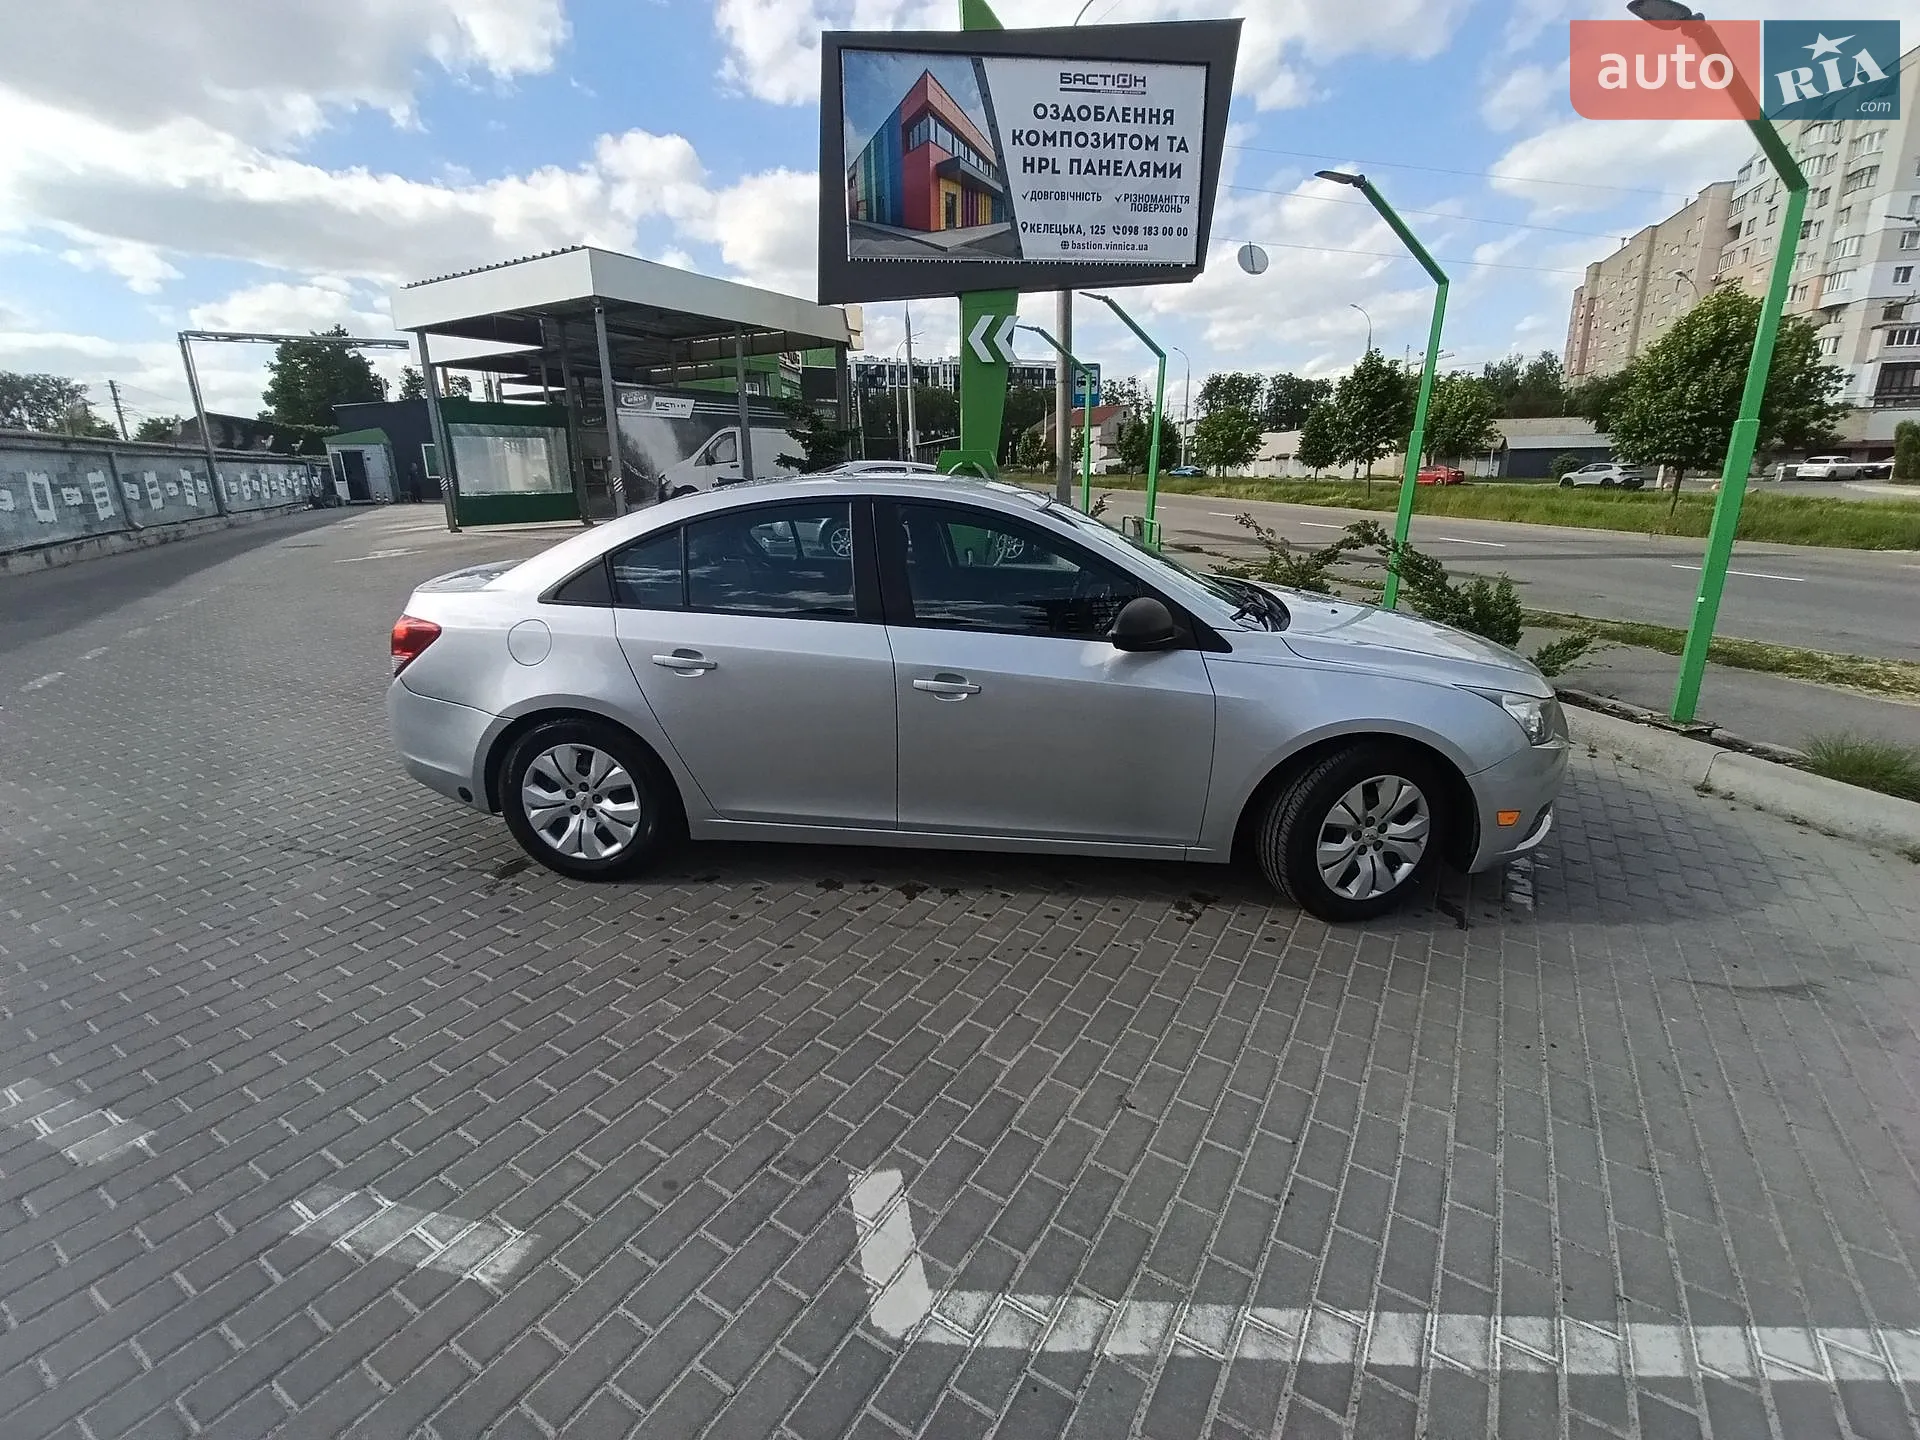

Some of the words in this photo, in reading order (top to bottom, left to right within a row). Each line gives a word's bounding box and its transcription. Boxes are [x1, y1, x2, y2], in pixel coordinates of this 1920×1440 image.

[1032, 102, 1176, 126] ОЗДОБЛЕННЯ
[1011, 128, 1159, 152] КОМПОЗИТОМ
[1166, 135, 1190, 154] ТА
[1021, 155, 1061, 176] HPL
[1069, 157, 1182, 180] ПАНЕЛЯМИ
[1029, 190, 1103, 203] ДОВГОВІЧНІСТЬ
[1123, 193, 1190, 205] РІЗНОМАНІТТЯ
[1130, 203, 1183, 214] ПОВЕРХОНЬ
[1029, 222, 1086, 237] КЕЛЕЦЬКА,
[1089, 225, 1106, 236] 125
[1121, 225, 1140, 236] 098
[1142, 226, 1160, 237] 183
[1161, 226, 1174, 237] 00
[1176, 226, 1189, 237] 00
[1071, 240, 1150, 252] bastion.vinnica.ua
